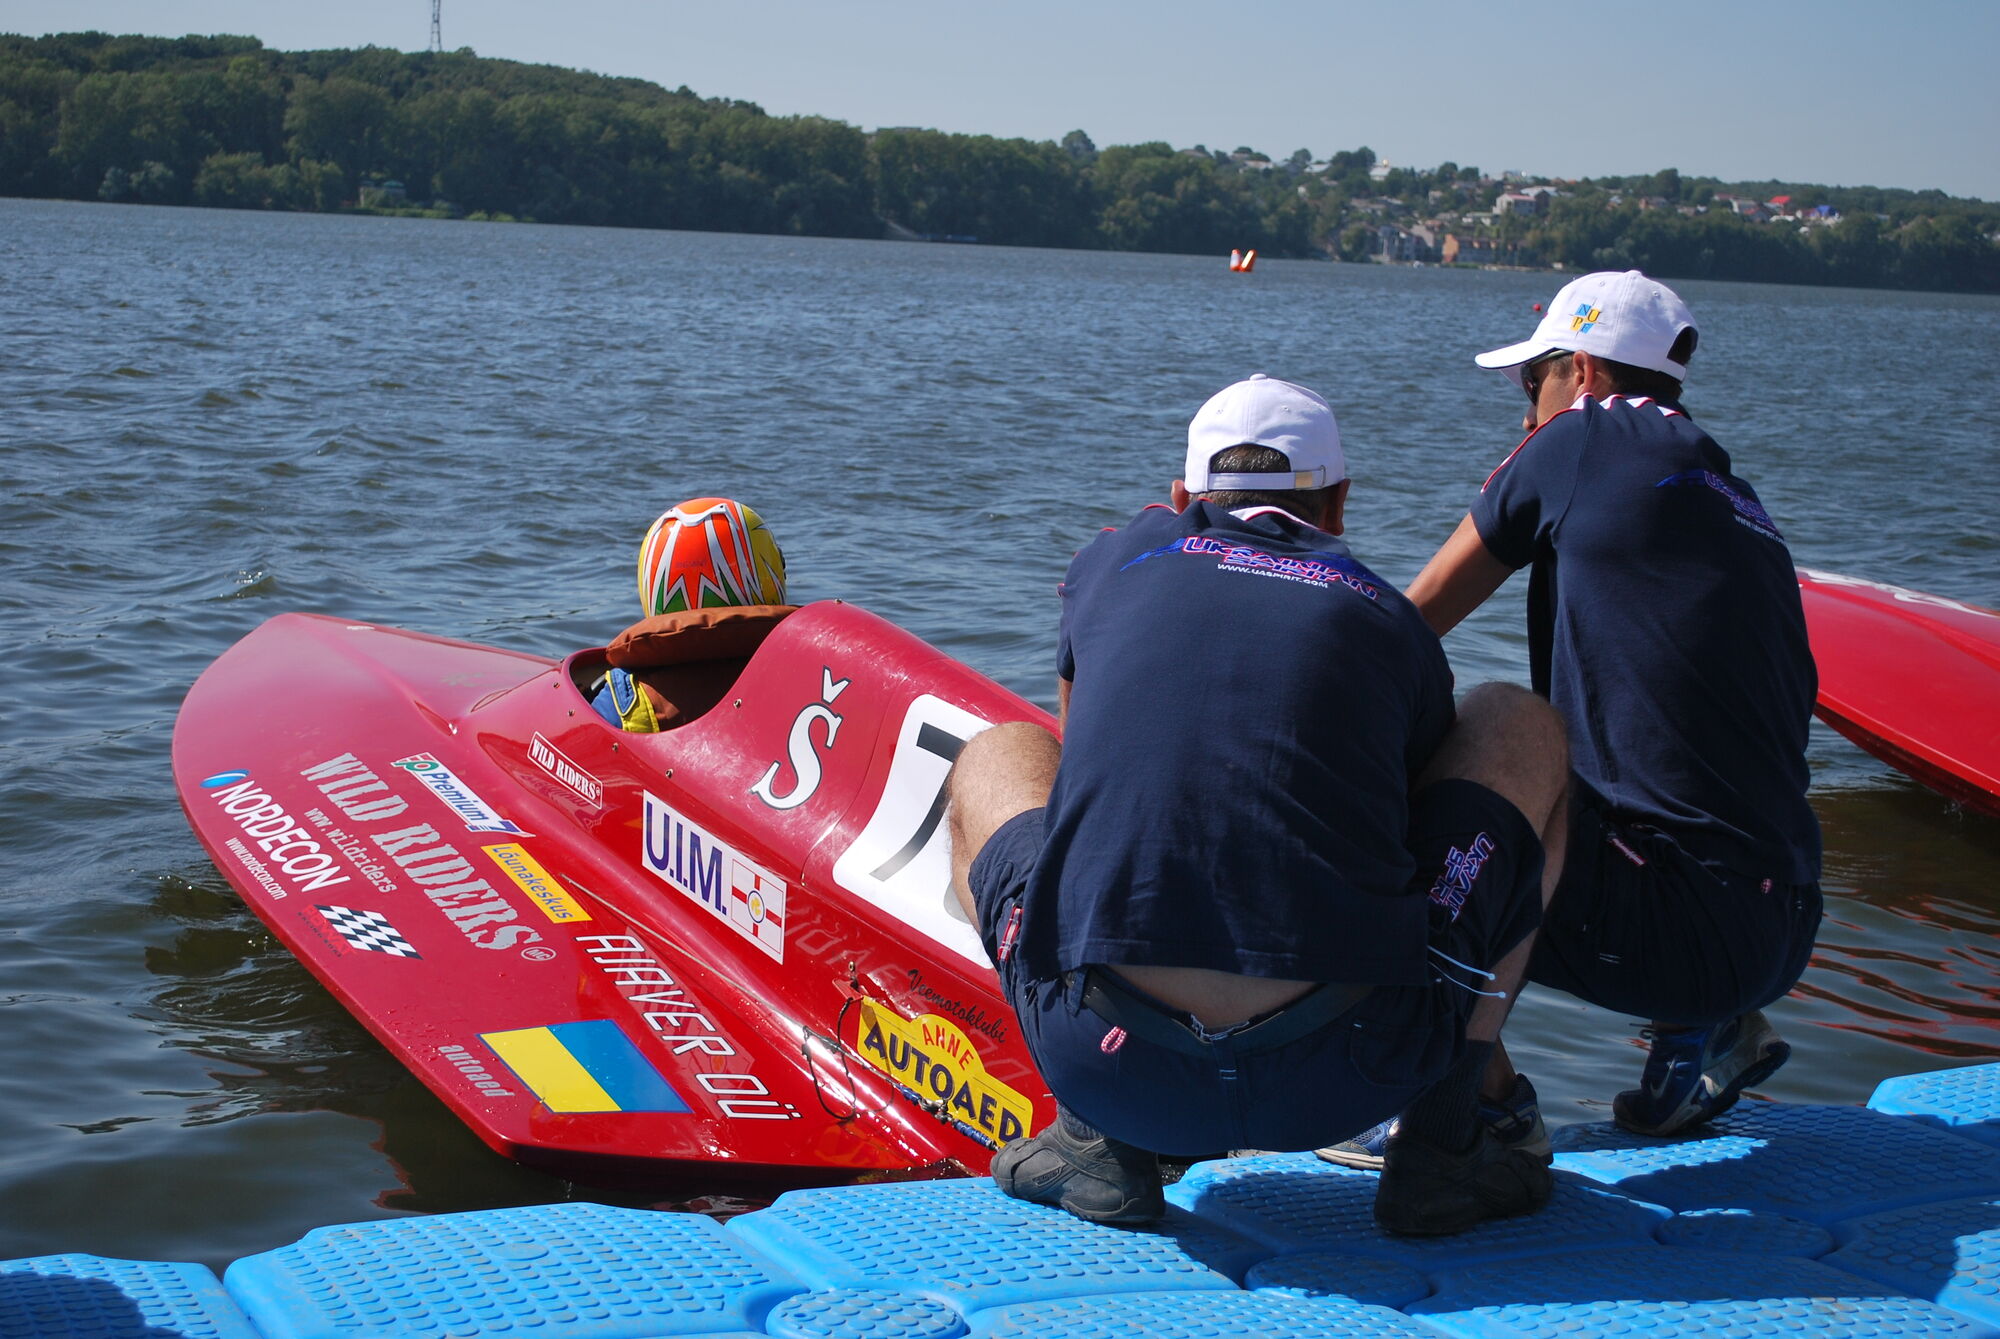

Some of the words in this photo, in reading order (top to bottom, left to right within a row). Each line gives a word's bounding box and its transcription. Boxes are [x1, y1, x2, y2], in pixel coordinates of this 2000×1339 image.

[1183, 536, 1378, 600] UKRAINIAN
[1224, 554, 1338, 583] SPIRIT
[422, 772, 490, 821] Premium
[532, 738, 555, 771] WILD
[556, 758, 596, 800] RIDERS
[211, 780, 352, 892] NORDECON
[225, 837, 288, 900] www.nordecon.com
[300, 752, 409, 821] WILD
[369, 823, 543, 950] RIDERS
[646, 801, 728, 916] U.I.M.
[491, 846, 575, 919] Lõunakeskus
[575, 935, 737, 1056] AJAVER
[695, 1072, 802, 1121] OÜ
[907, 969, 1008, 1043] Veemotoklubi
[438, 1044, 516, 1096] autoaed
[921, 1023, 975, 1071] ANNE
[863, 1021, 1025, 1144] AUTOAED
